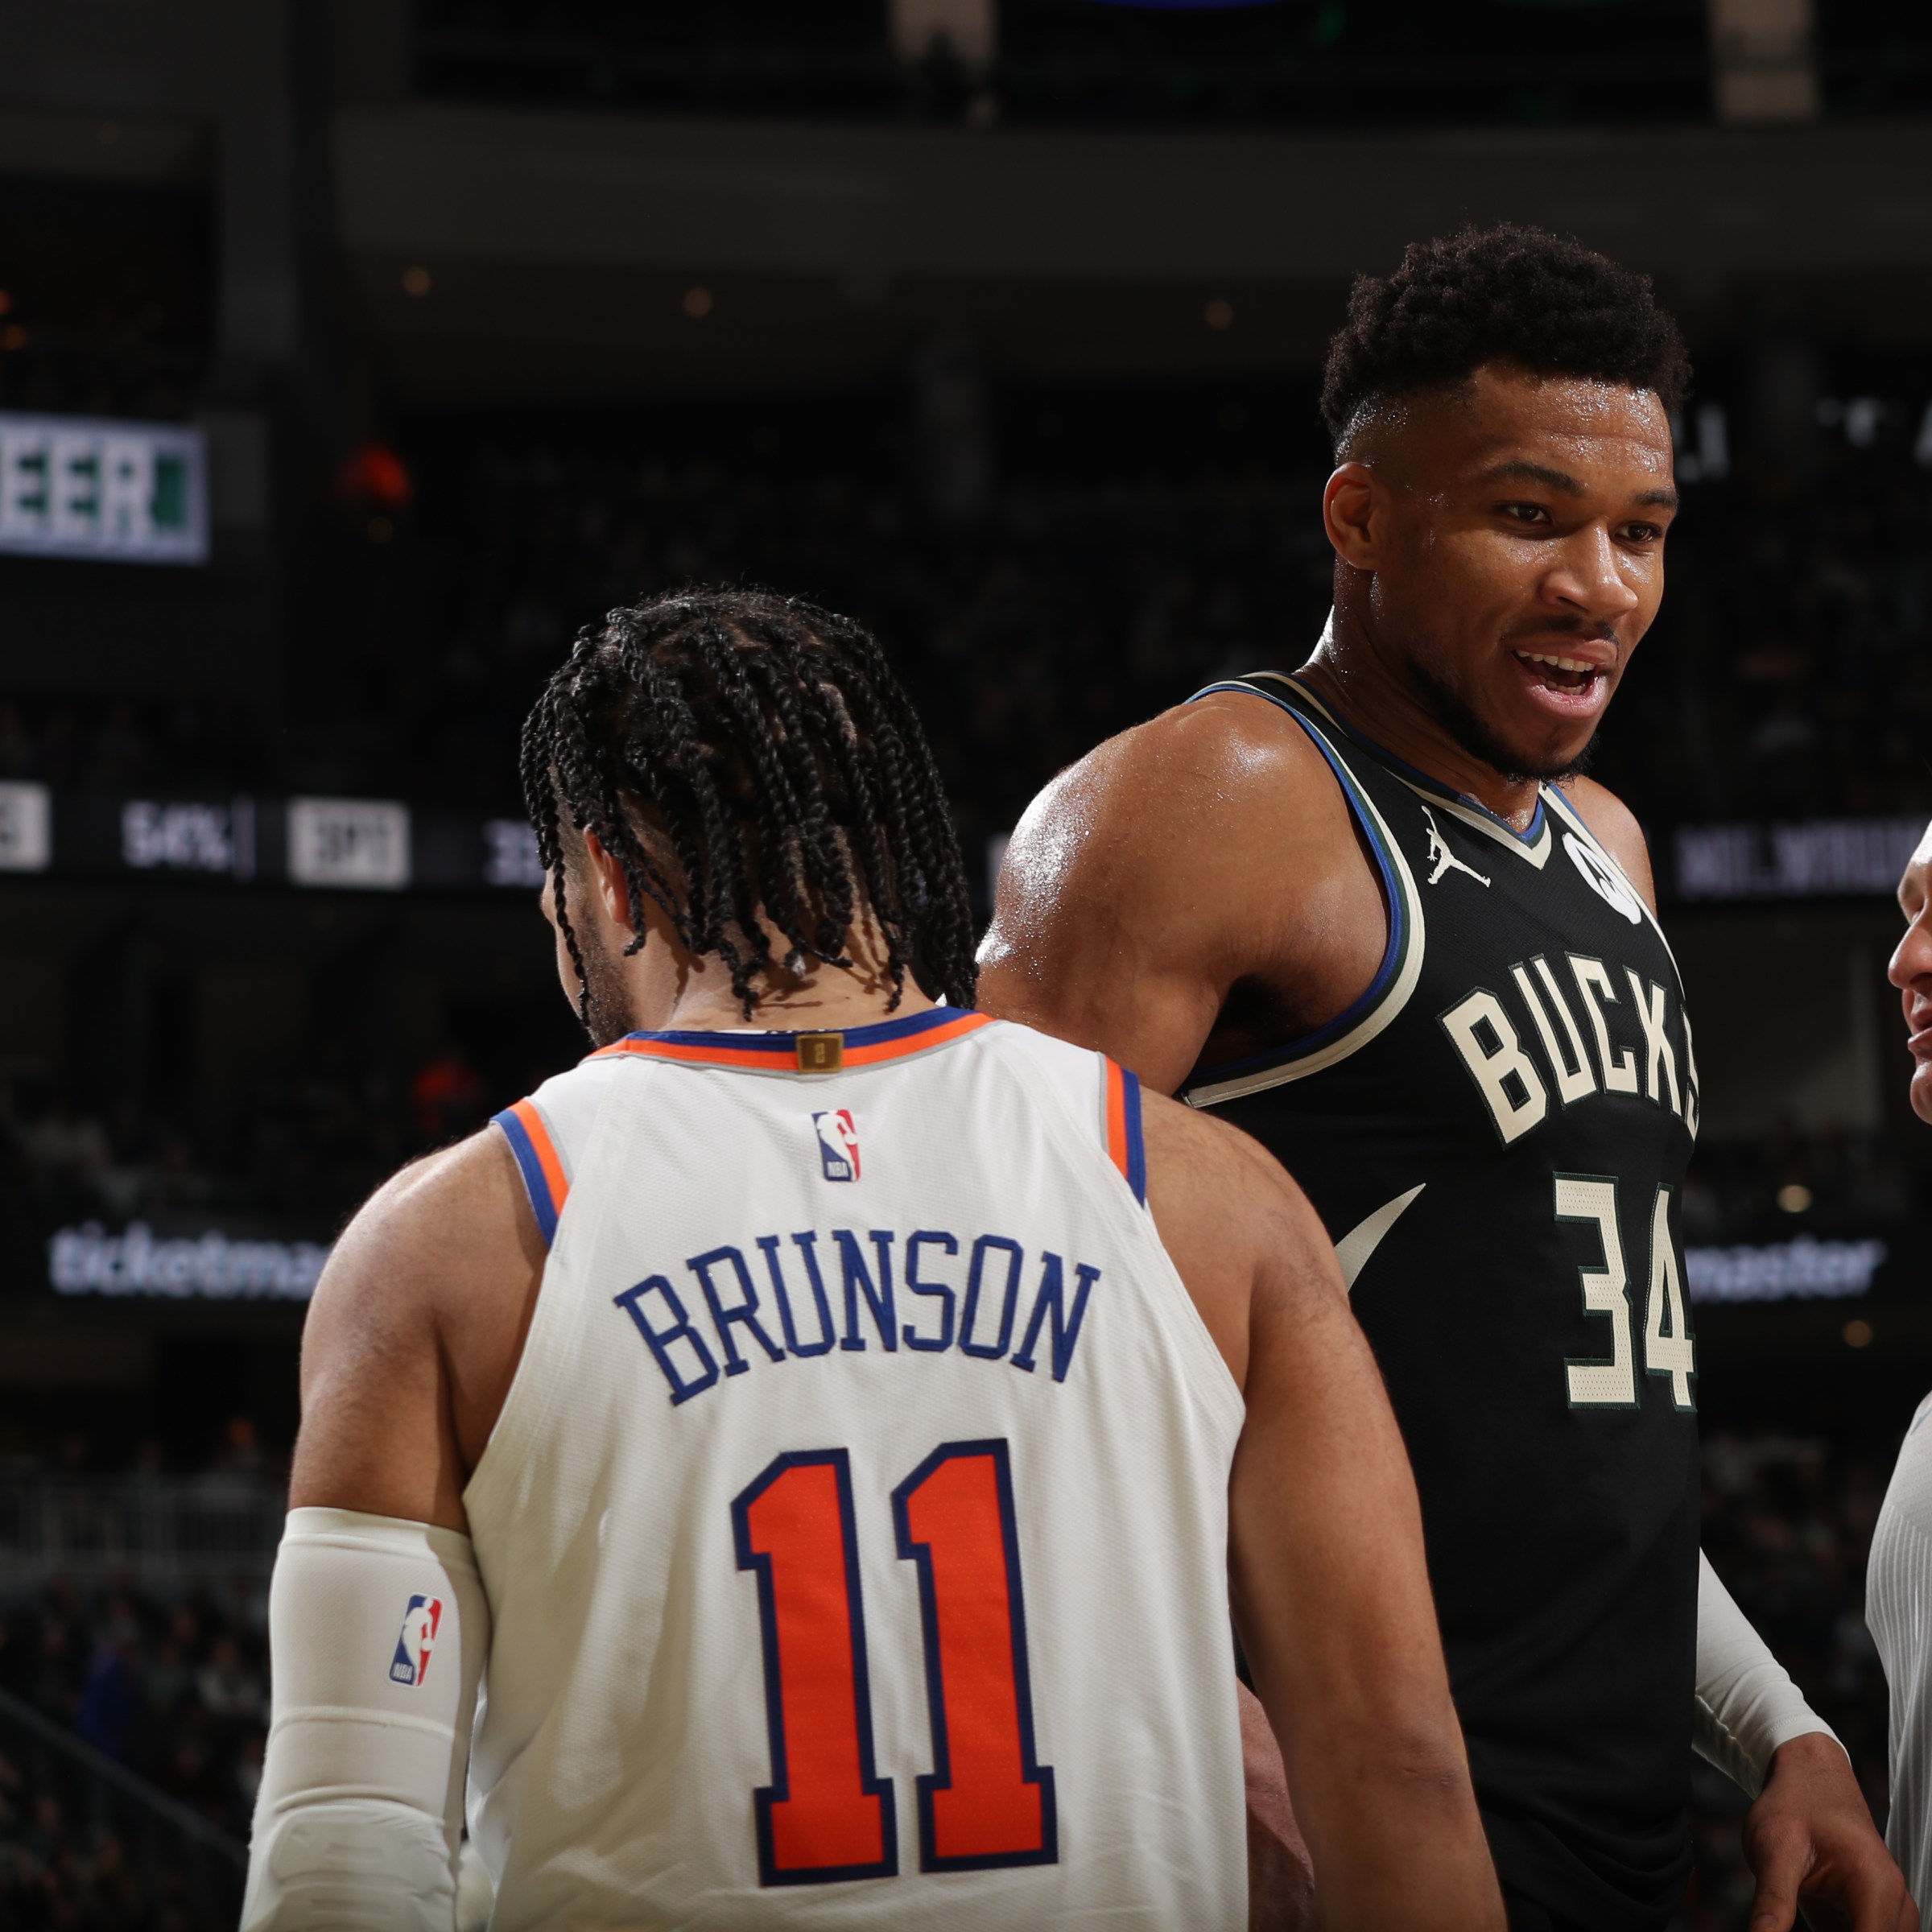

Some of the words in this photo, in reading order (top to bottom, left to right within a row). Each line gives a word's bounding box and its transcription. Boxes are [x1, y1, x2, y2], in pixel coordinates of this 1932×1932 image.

[826, 1160, 849, 1179] NBA
[613, 1229, 1101, 1406] BRUNSON
[1552, 1171, 1698, 1412] 34
[392, 1662, 414, 1682] NBA
[730, 1438, 1059, 1888] 11
